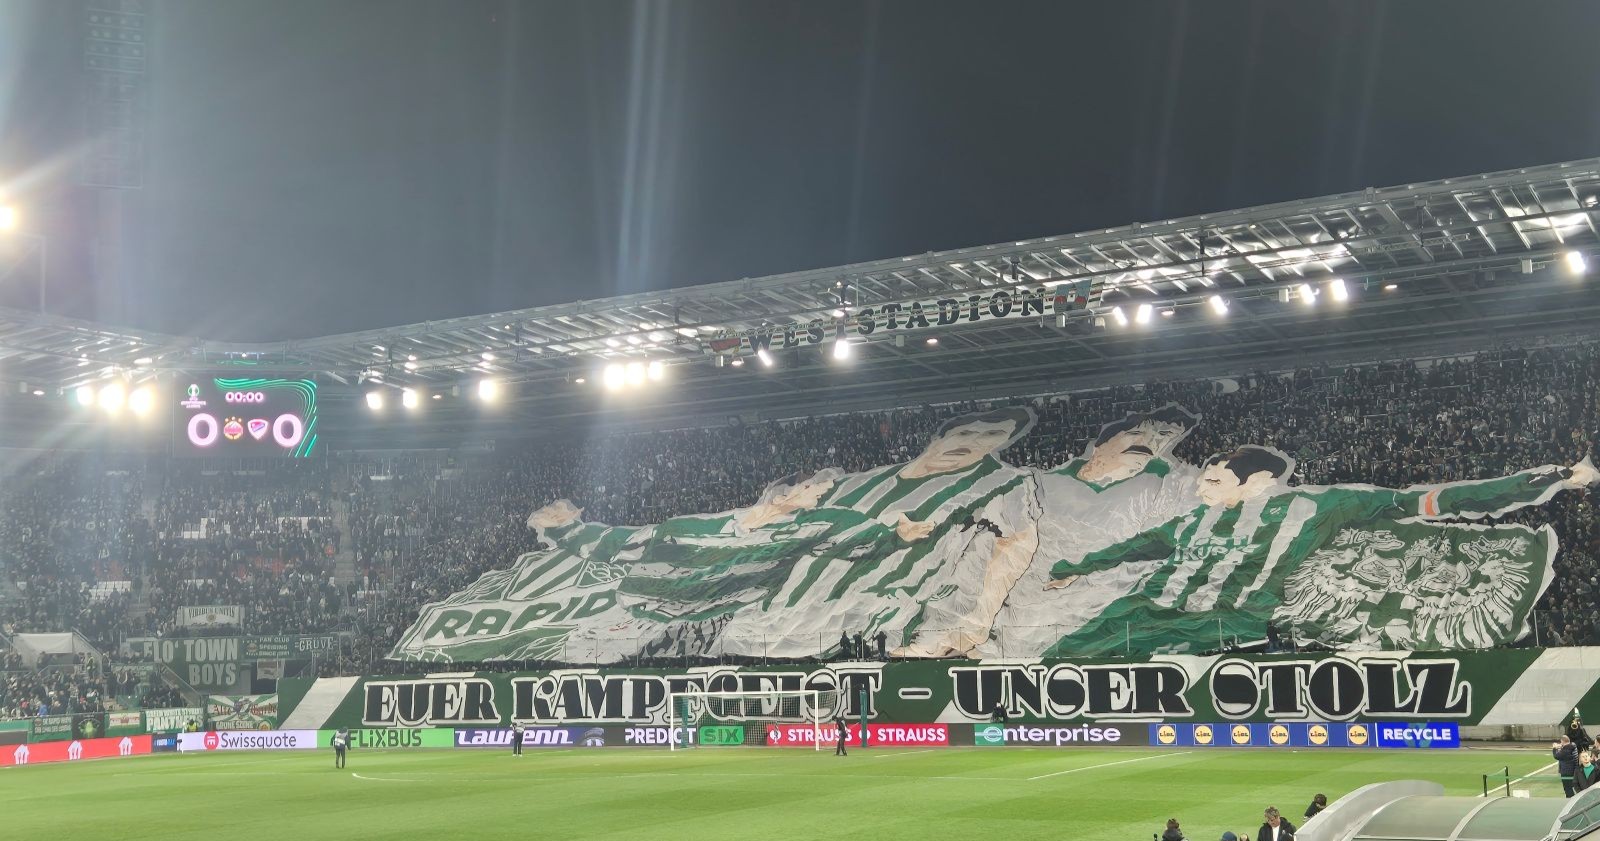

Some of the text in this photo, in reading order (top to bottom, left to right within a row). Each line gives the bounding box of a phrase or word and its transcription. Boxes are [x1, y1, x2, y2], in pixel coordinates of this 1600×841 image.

[225, 391, 264, 403] 00:00
[187, 413, 218, 446] 0
[273, 413, 302, 447] 0
[423, 588, 618, 641] RAPID
[183, 638, 239, 662] TOWN
[188, 662, 237, 686] BOYS
[363, 679, 500, 726] EUER
[512, 669, 883, 725] KAMPFGEIST
[949, 664, 1194, 719] UNSER
[1210, 658, 1471, 721] STOLZ
[221, 732, 297, 748] Swissquote
[625, 727, 739, 744] PREDICT SIX
[877, 728, 946, 741] STRAUSS
[983, 723, 1121, 746] enterprise
[1383, 728, 1452, 741] RECYCLE
